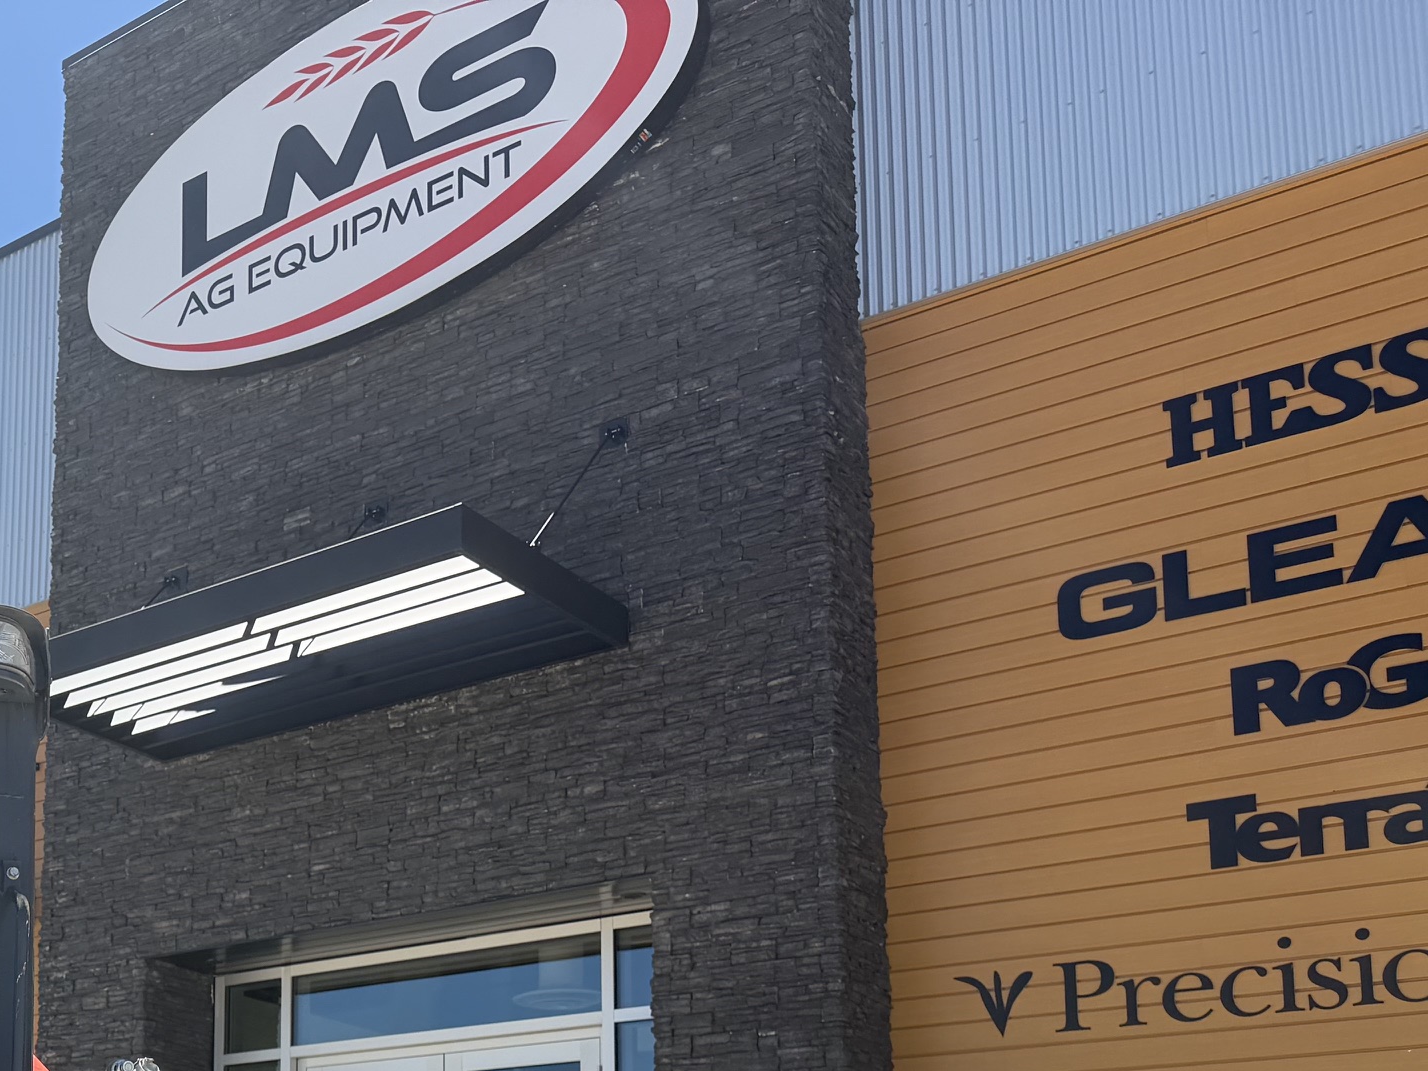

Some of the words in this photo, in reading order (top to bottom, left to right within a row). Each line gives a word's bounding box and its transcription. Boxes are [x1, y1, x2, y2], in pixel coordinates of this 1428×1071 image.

[181, 0, 557, 278] LMS
[177, 274, 236, 328] AG
[247, 140, 523, 295] EQUIPMENT
[1056, 494, 1428, 641] GLEA
